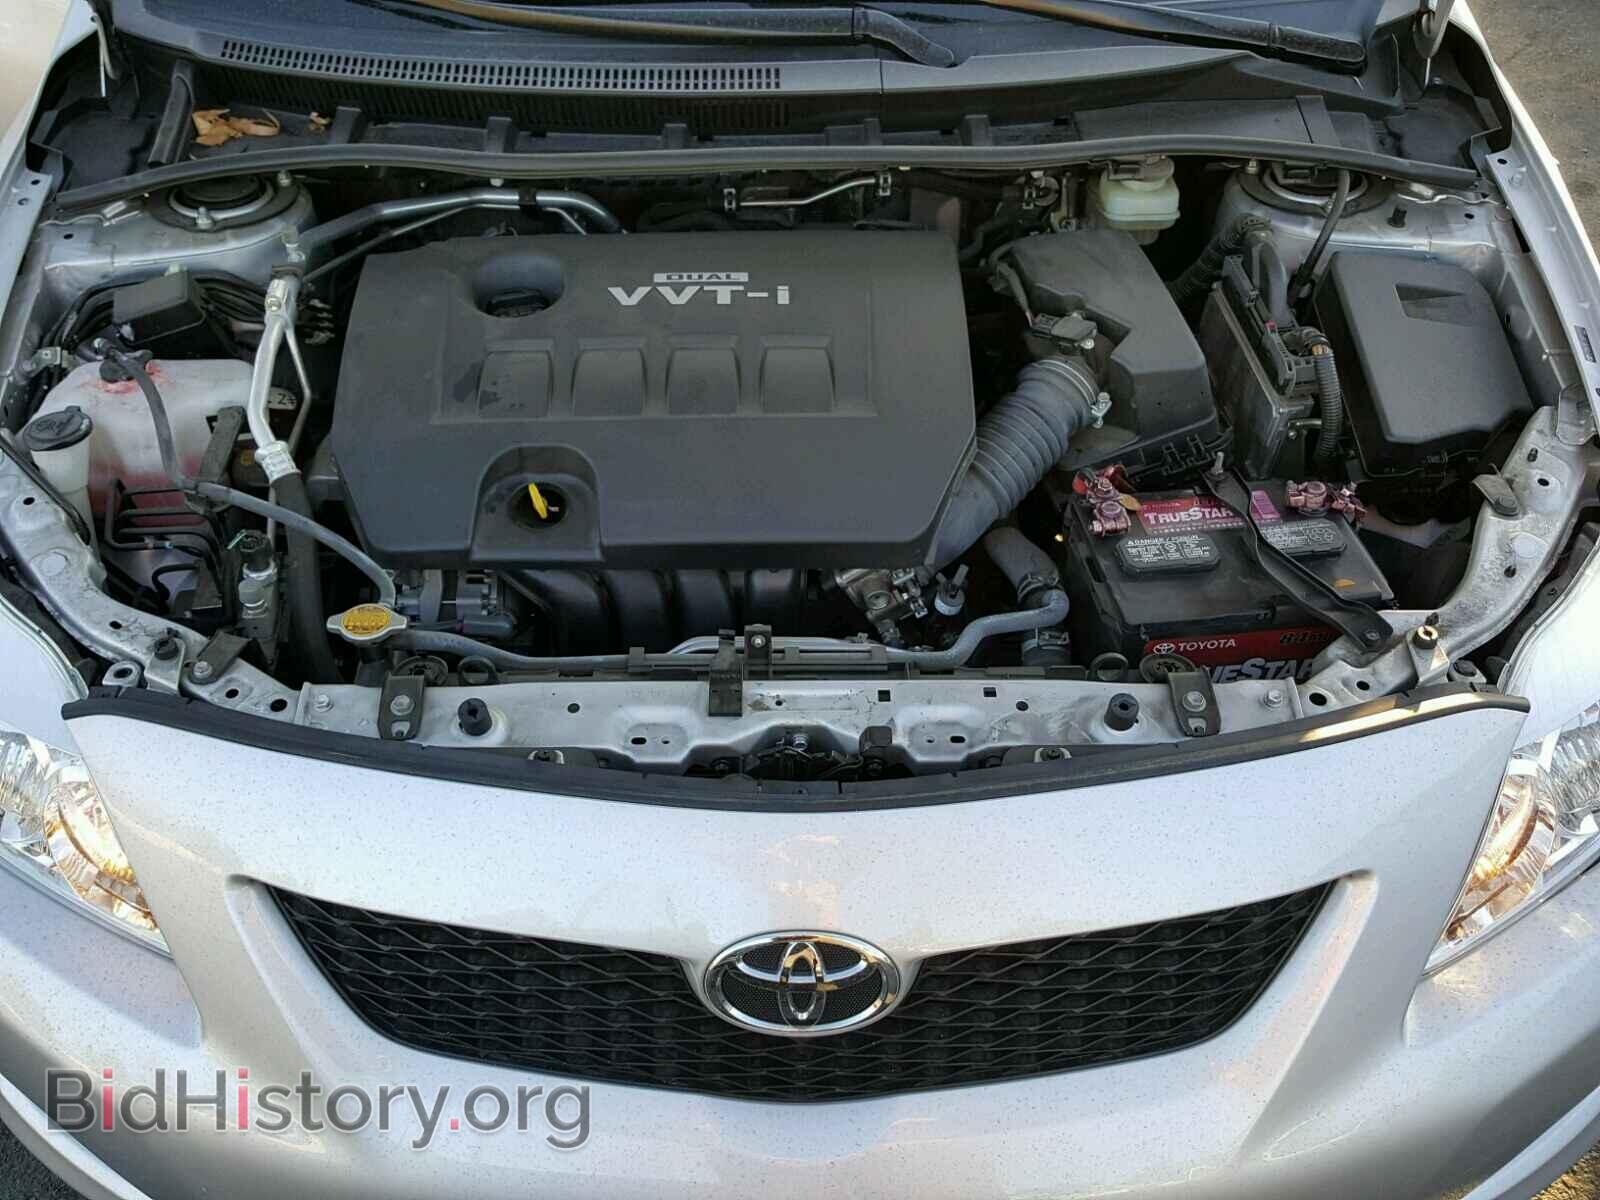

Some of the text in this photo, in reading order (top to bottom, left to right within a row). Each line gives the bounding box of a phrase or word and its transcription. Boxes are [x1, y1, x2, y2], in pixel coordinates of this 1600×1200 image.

[664, 273, 743, 281] DUAL
[608, 285, 789, 305] VVT-i
[1178, 638, 1236, 652] TOYOTA
